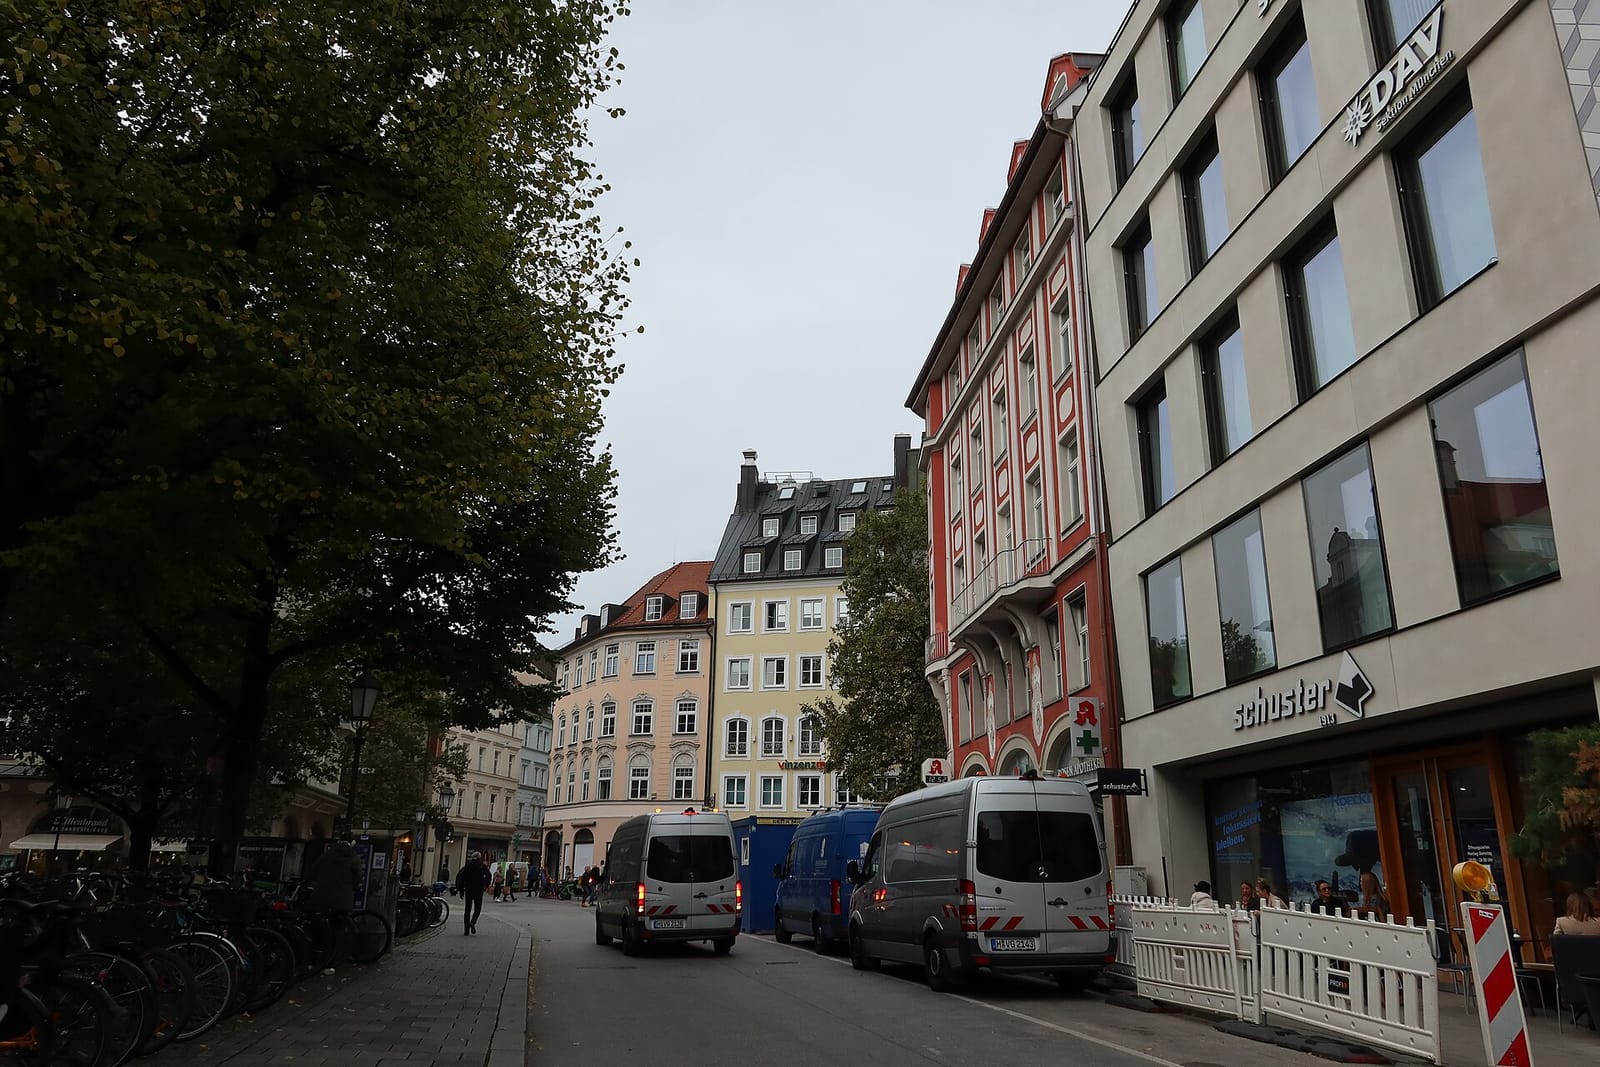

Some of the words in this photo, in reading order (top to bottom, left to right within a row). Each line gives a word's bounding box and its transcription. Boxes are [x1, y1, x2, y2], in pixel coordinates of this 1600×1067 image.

[1368, 5, 1444, 116] DAV
[1376, 97, 1411, 134] Sektion
[1410, 49, 1455, 99] München
[1232, 678, 1333, 731] schuster
[1319, 713, 1338, 727] 1913
[1073, 757, 1102, 776] APOTHEKE
[1102, 782, 1130, 791] schuster
